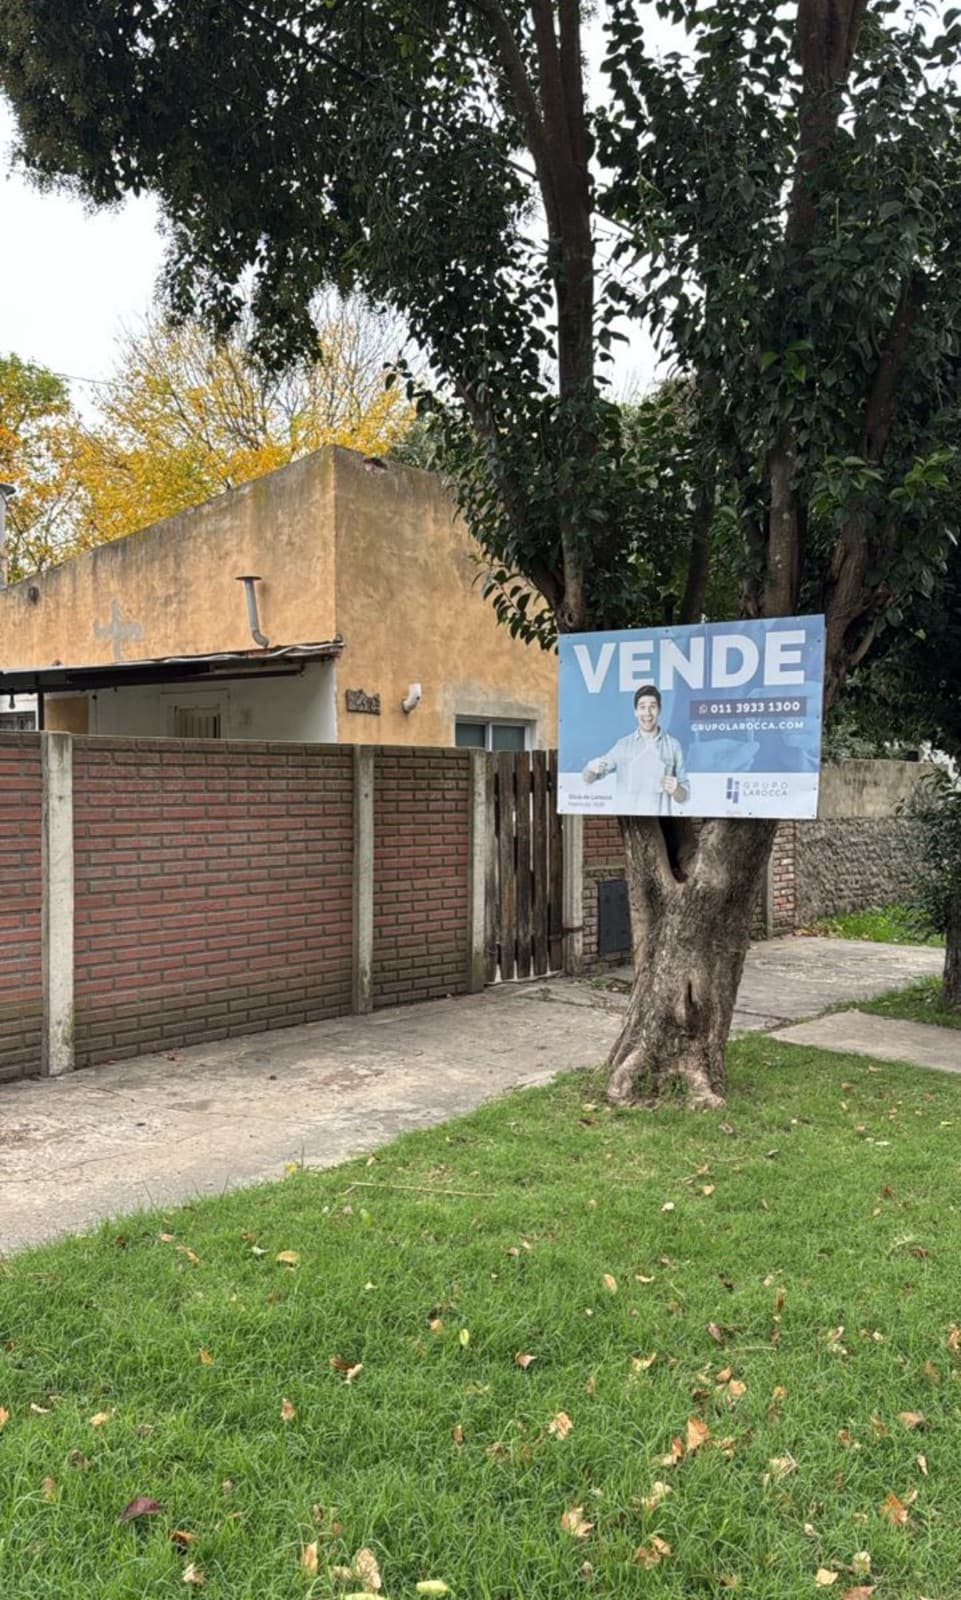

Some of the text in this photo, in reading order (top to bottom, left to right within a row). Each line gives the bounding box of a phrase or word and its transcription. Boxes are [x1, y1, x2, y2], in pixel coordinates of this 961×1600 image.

[573, 630, 806, 693] VENDE
[710, 701, 801, 714] 011 3933 1300
[690, 721, 805, 732] GRUPOLAROCCA.COM
[743, 781, 788, 789] GRUPO
[743, 789, 788, 797] LAROCCA
